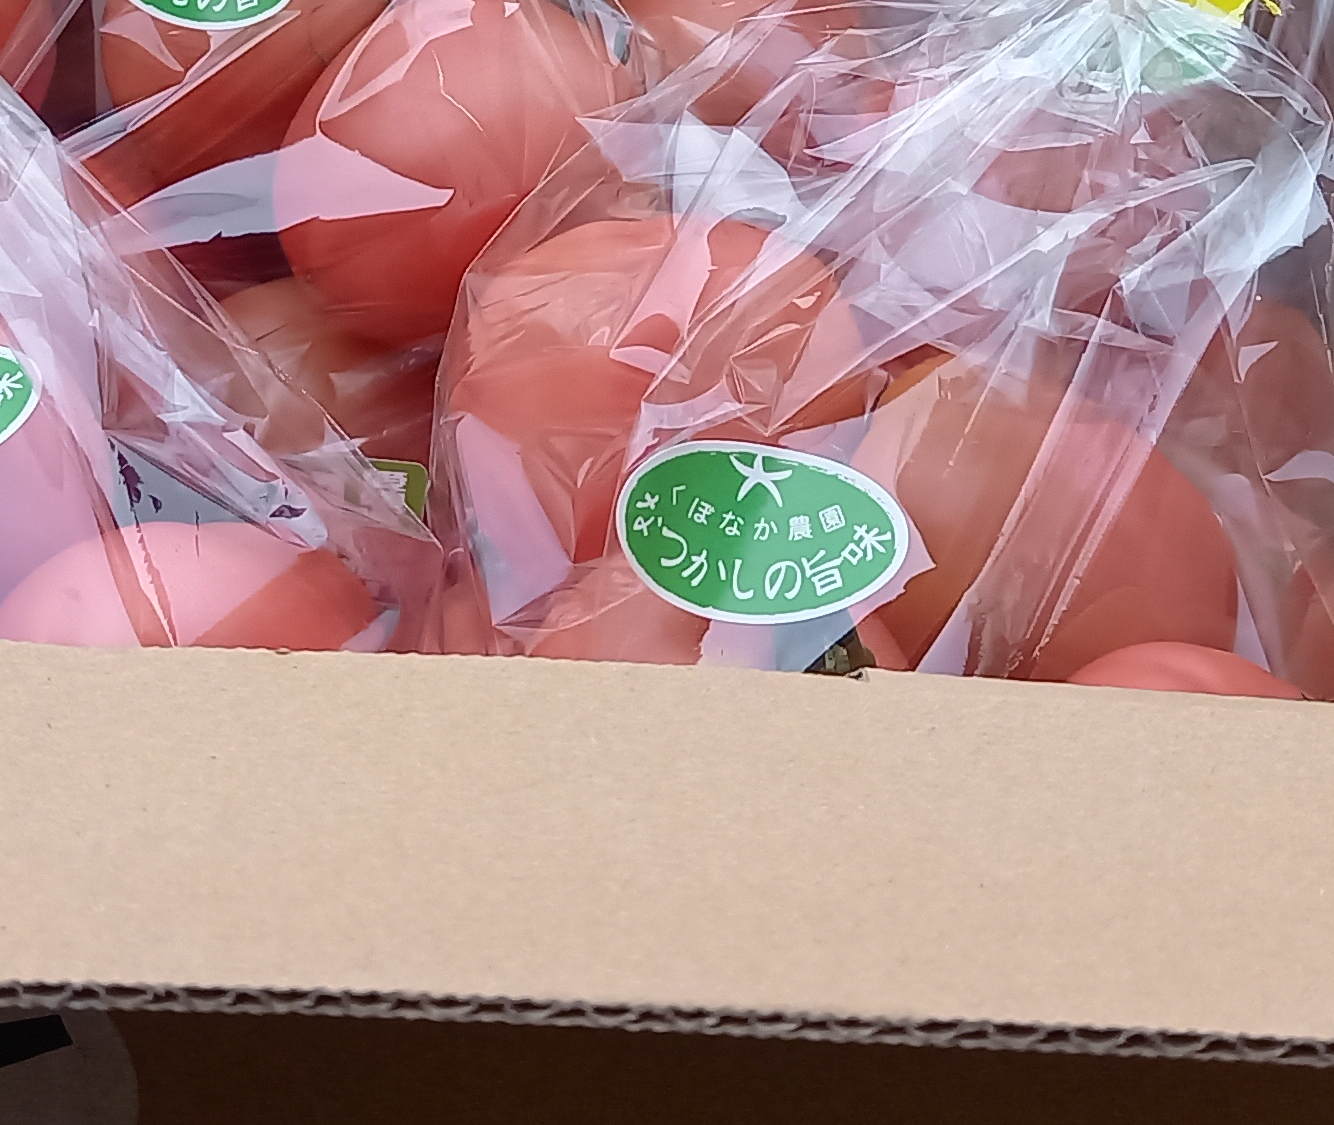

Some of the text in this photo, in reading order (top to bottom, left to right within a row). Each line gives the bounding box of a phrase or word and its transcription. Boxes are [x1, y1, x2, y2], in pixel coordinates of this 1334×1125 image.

[632, 491, 892, 601] なつかしの旨味
